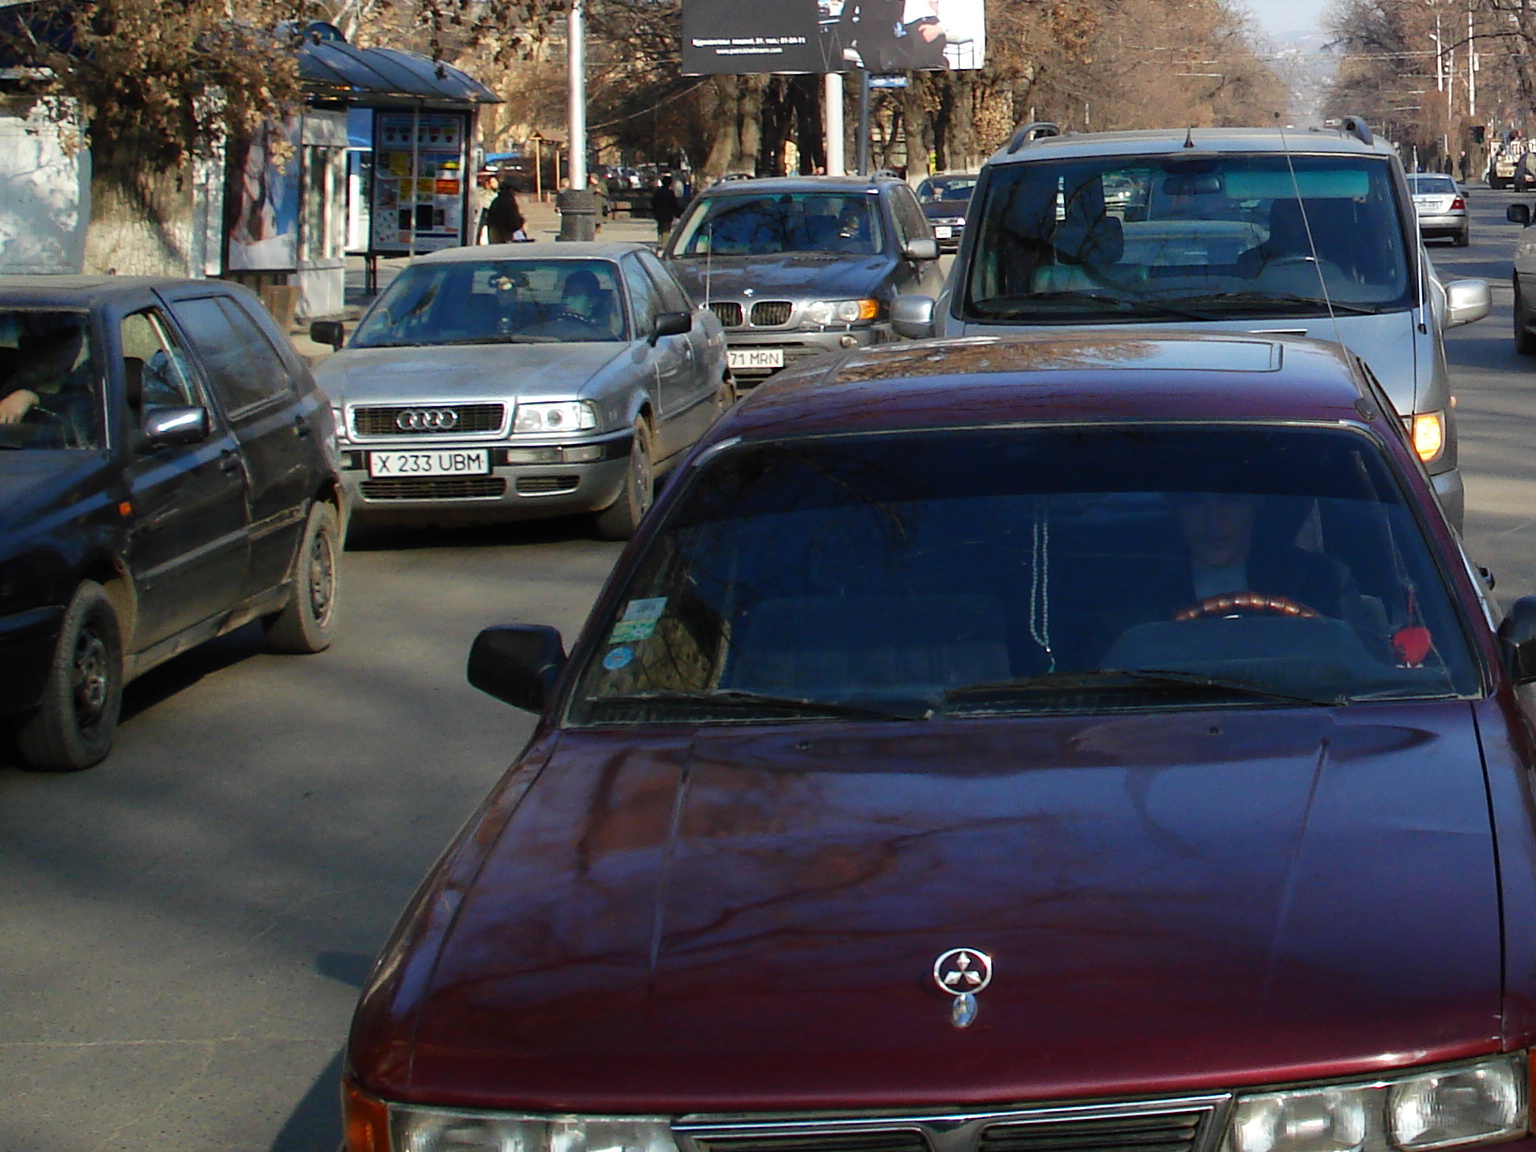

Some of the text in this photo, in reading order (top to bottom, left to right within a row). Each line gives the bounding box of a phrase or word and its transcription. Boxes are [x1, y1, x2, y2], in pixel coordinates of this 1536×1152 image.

[750, 352, 779, 365] MRN
[377, 453, 481, 473] X 233 UBM
